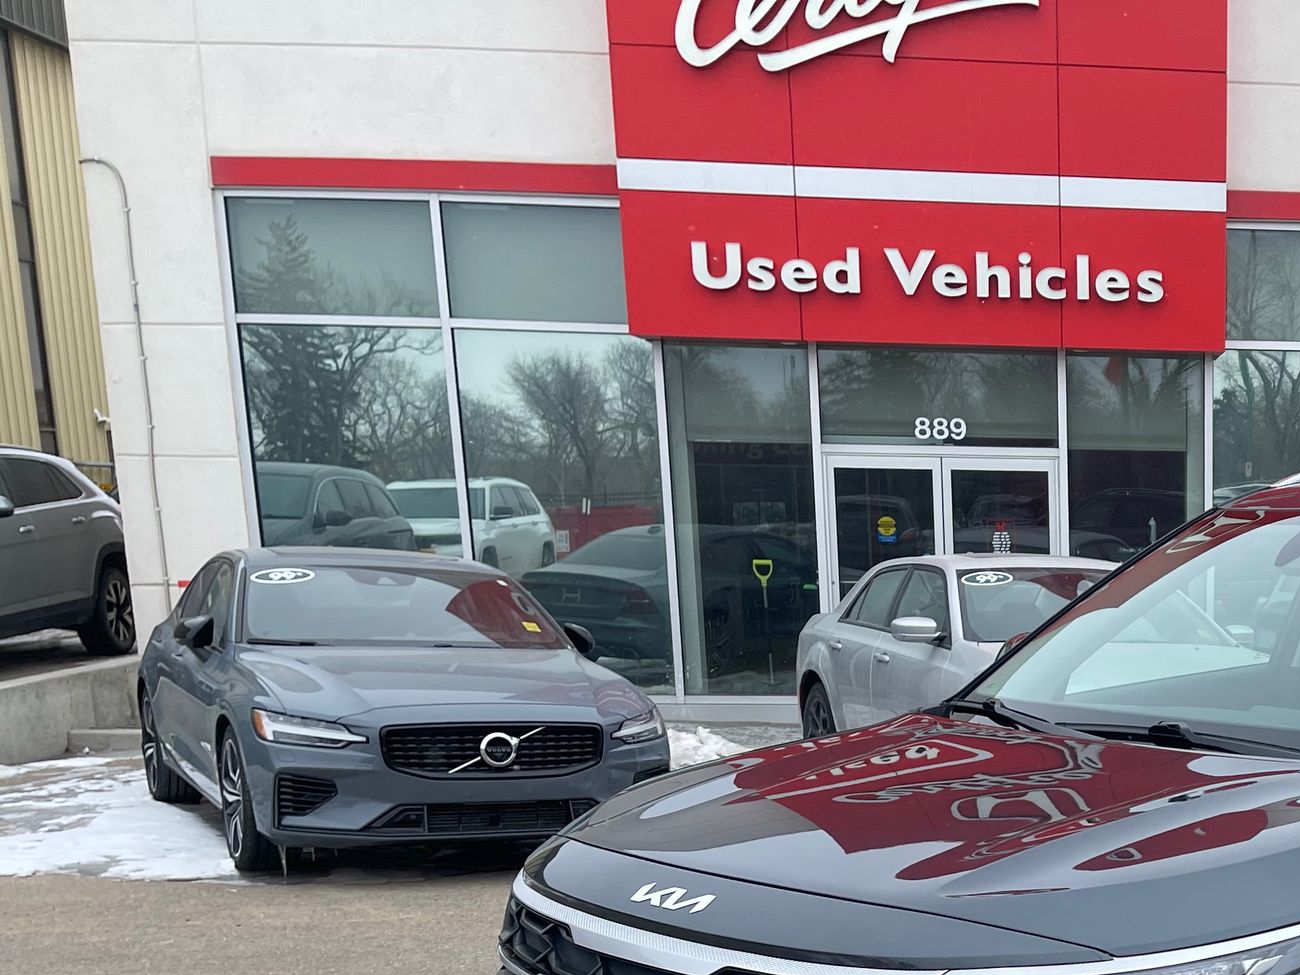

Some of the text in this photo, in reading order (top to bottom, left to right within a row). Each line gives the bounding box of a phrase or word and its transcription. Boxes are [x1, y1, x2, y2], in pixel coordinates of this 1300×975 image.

[690, 240, 1165, 302] Used Vehicles
[914, 416, 967, 440] 889
[630, 882, 717, 914] KIA
